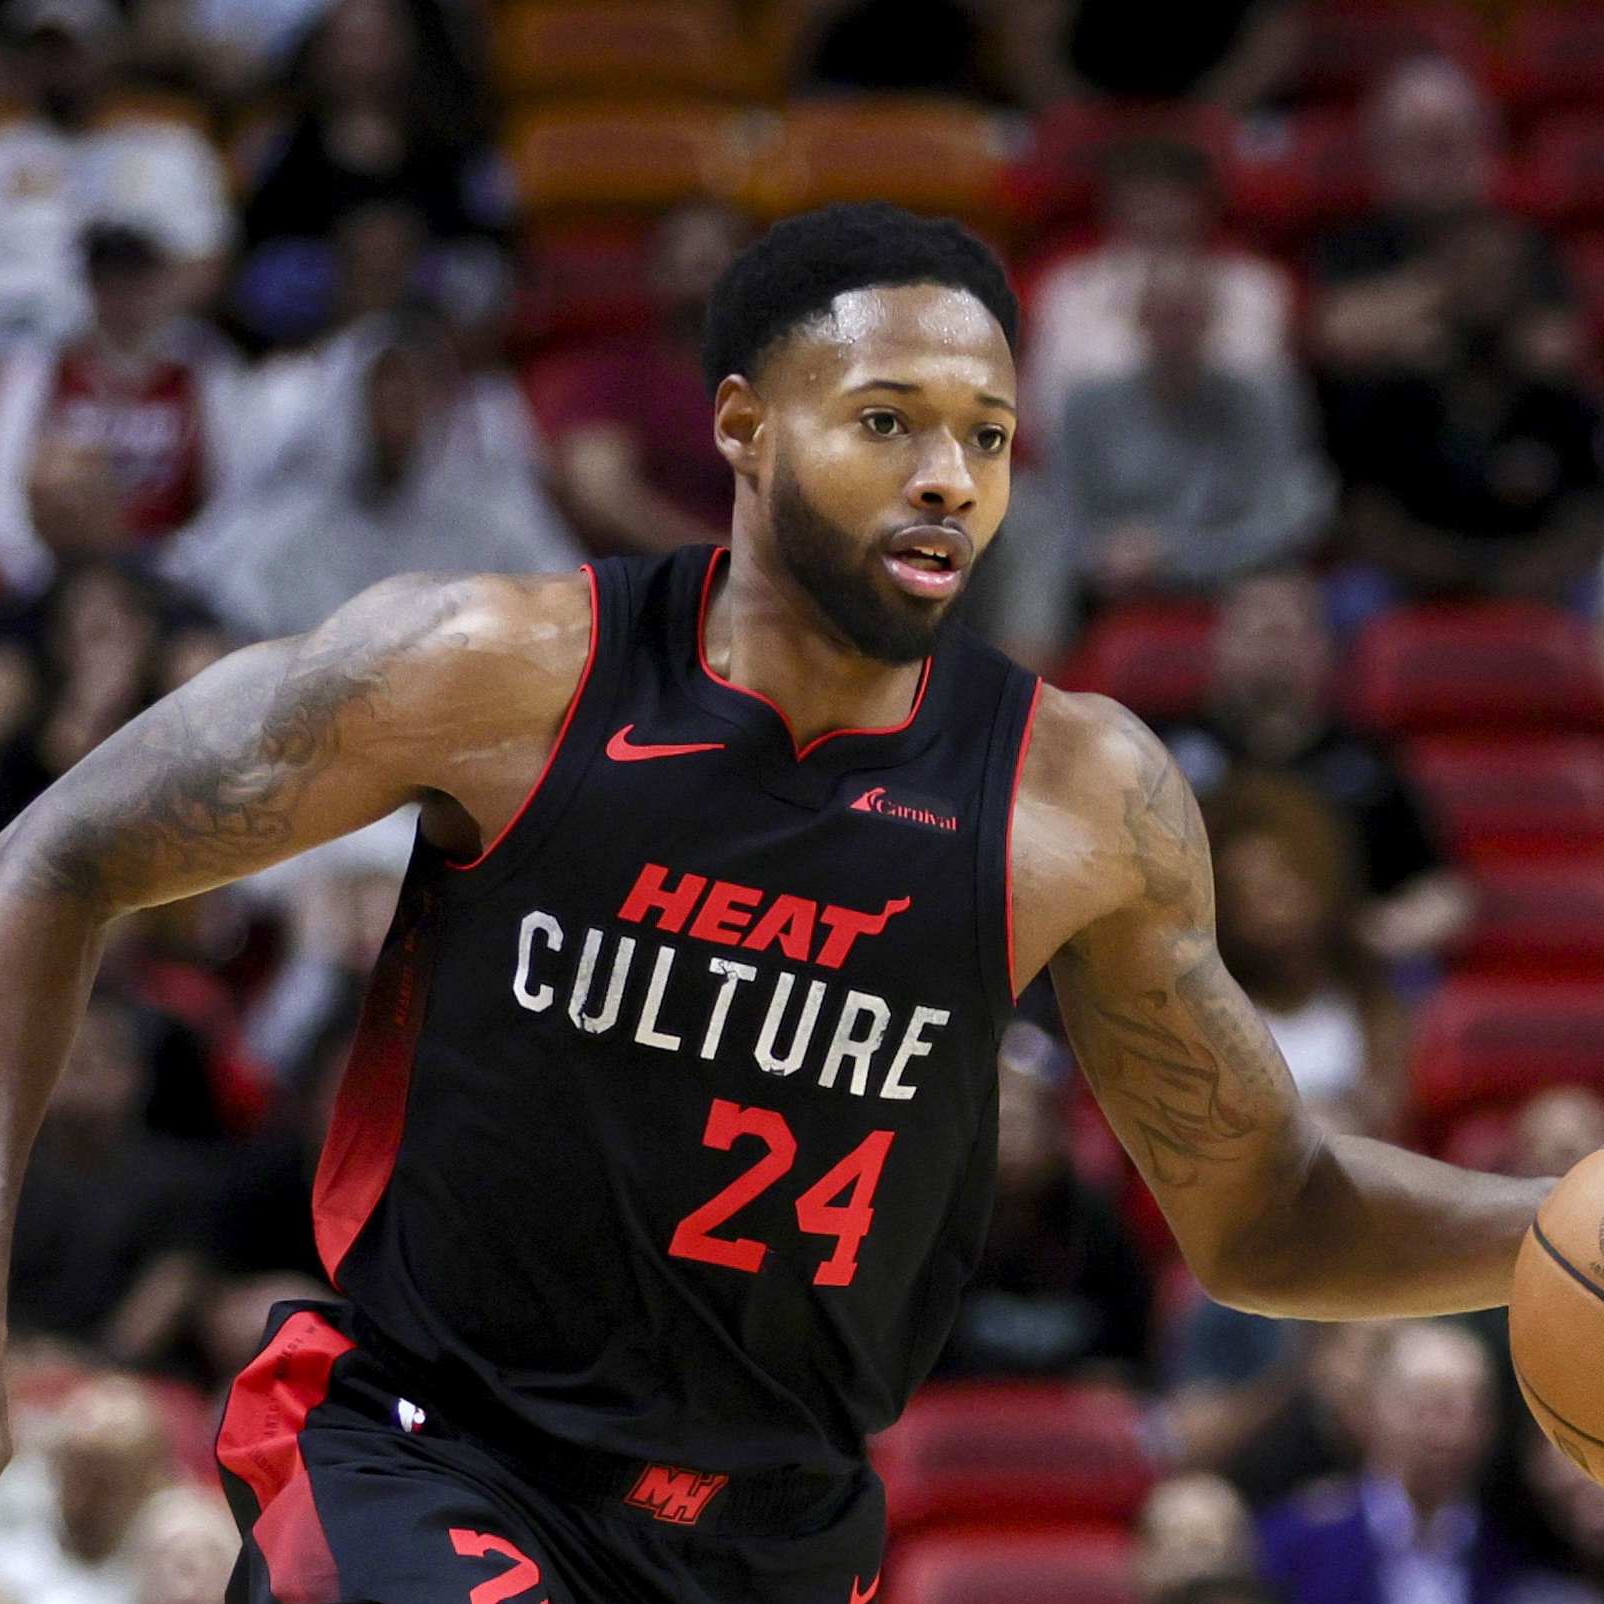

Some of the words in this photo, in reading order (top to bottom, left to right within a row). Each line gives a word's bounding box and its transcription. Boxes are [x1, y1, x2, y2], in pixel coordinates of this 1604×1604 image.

[875, 798, 959, 833] Carnival
[617, 862, 911, 969] HEAT
[512, 910, 951, 1100] CULTURE
[667, 1097, 896, 1287] 24
